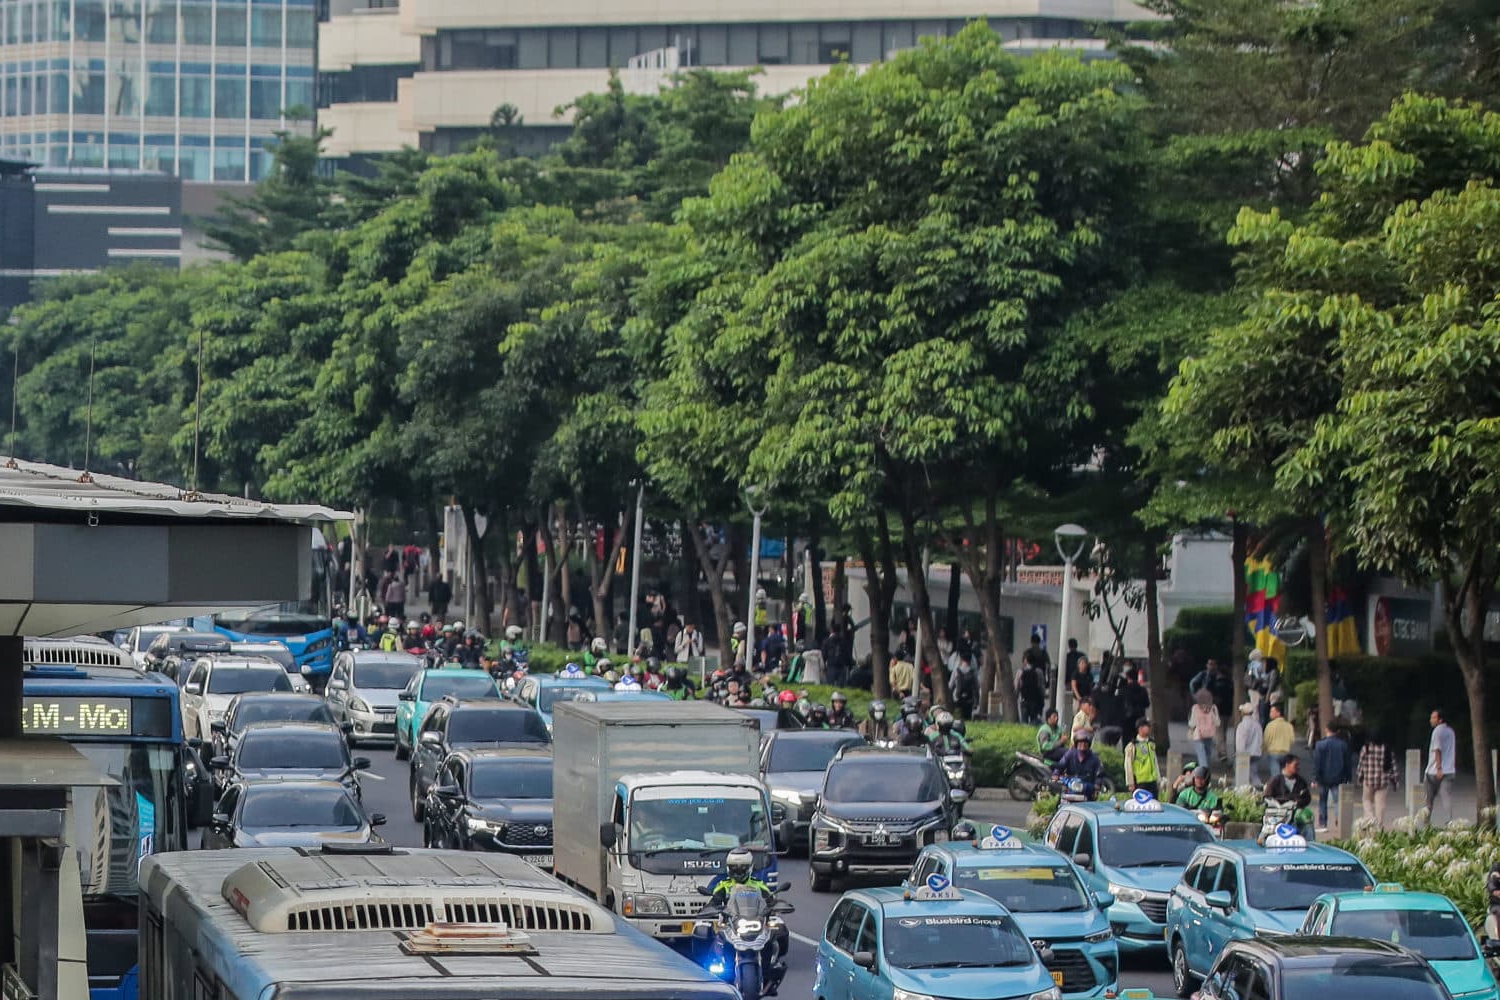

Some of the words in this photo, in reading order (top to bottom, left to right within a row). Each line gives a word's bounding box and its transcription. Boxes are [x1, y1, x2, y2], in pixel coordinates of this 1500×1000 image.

[33, 704, 59, 728] M
[683, 861, 721, 869] ISUZU
[1326, 864, 1352, 872] Group
[925, 916, 972, 926] Bluebird
[973, 918, 1002, 926] Group
